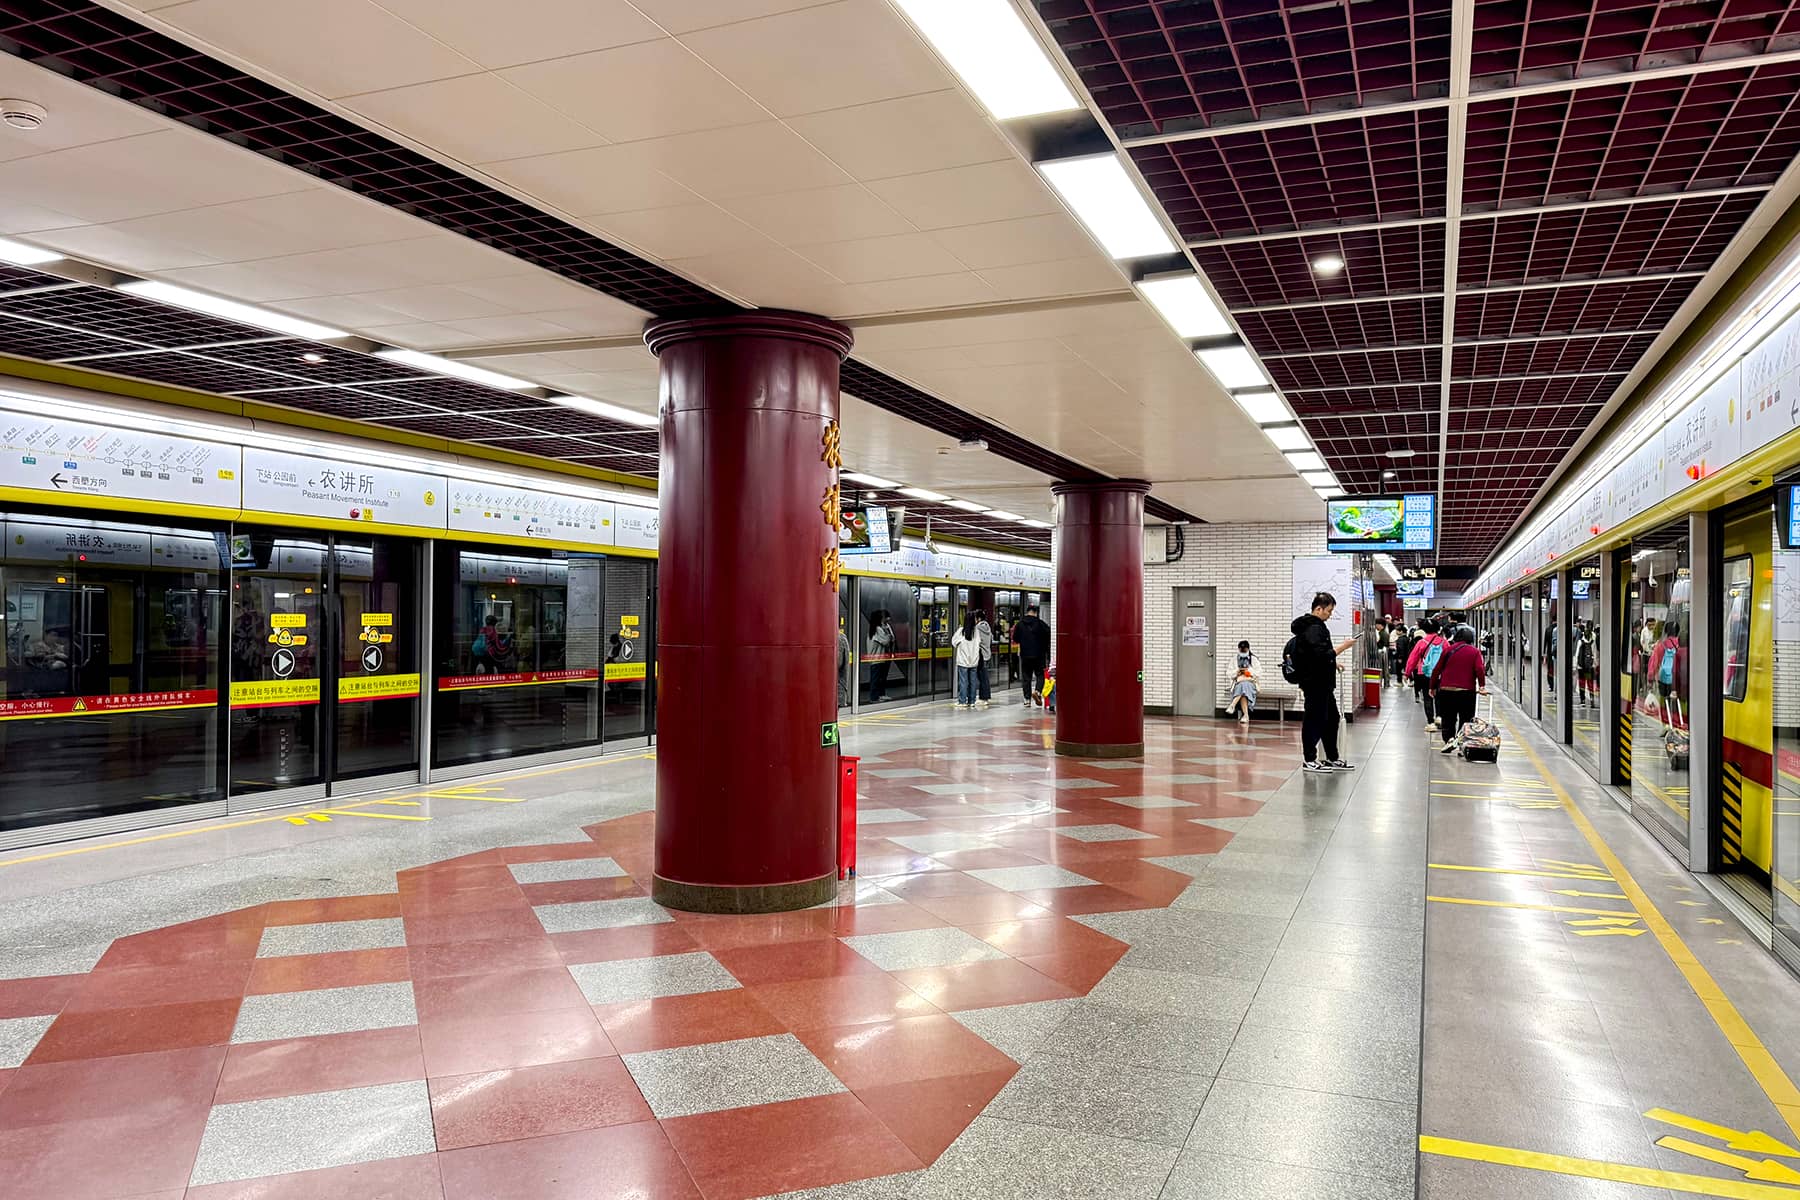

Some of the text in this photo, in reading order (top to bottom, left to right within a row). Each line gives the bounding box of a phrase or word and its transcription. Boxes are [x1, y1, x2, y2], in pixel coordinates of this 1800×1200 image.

[320, 468, 374, 495] 农讲所
[302, 490, 389, 508] Peasant Movement Institute
